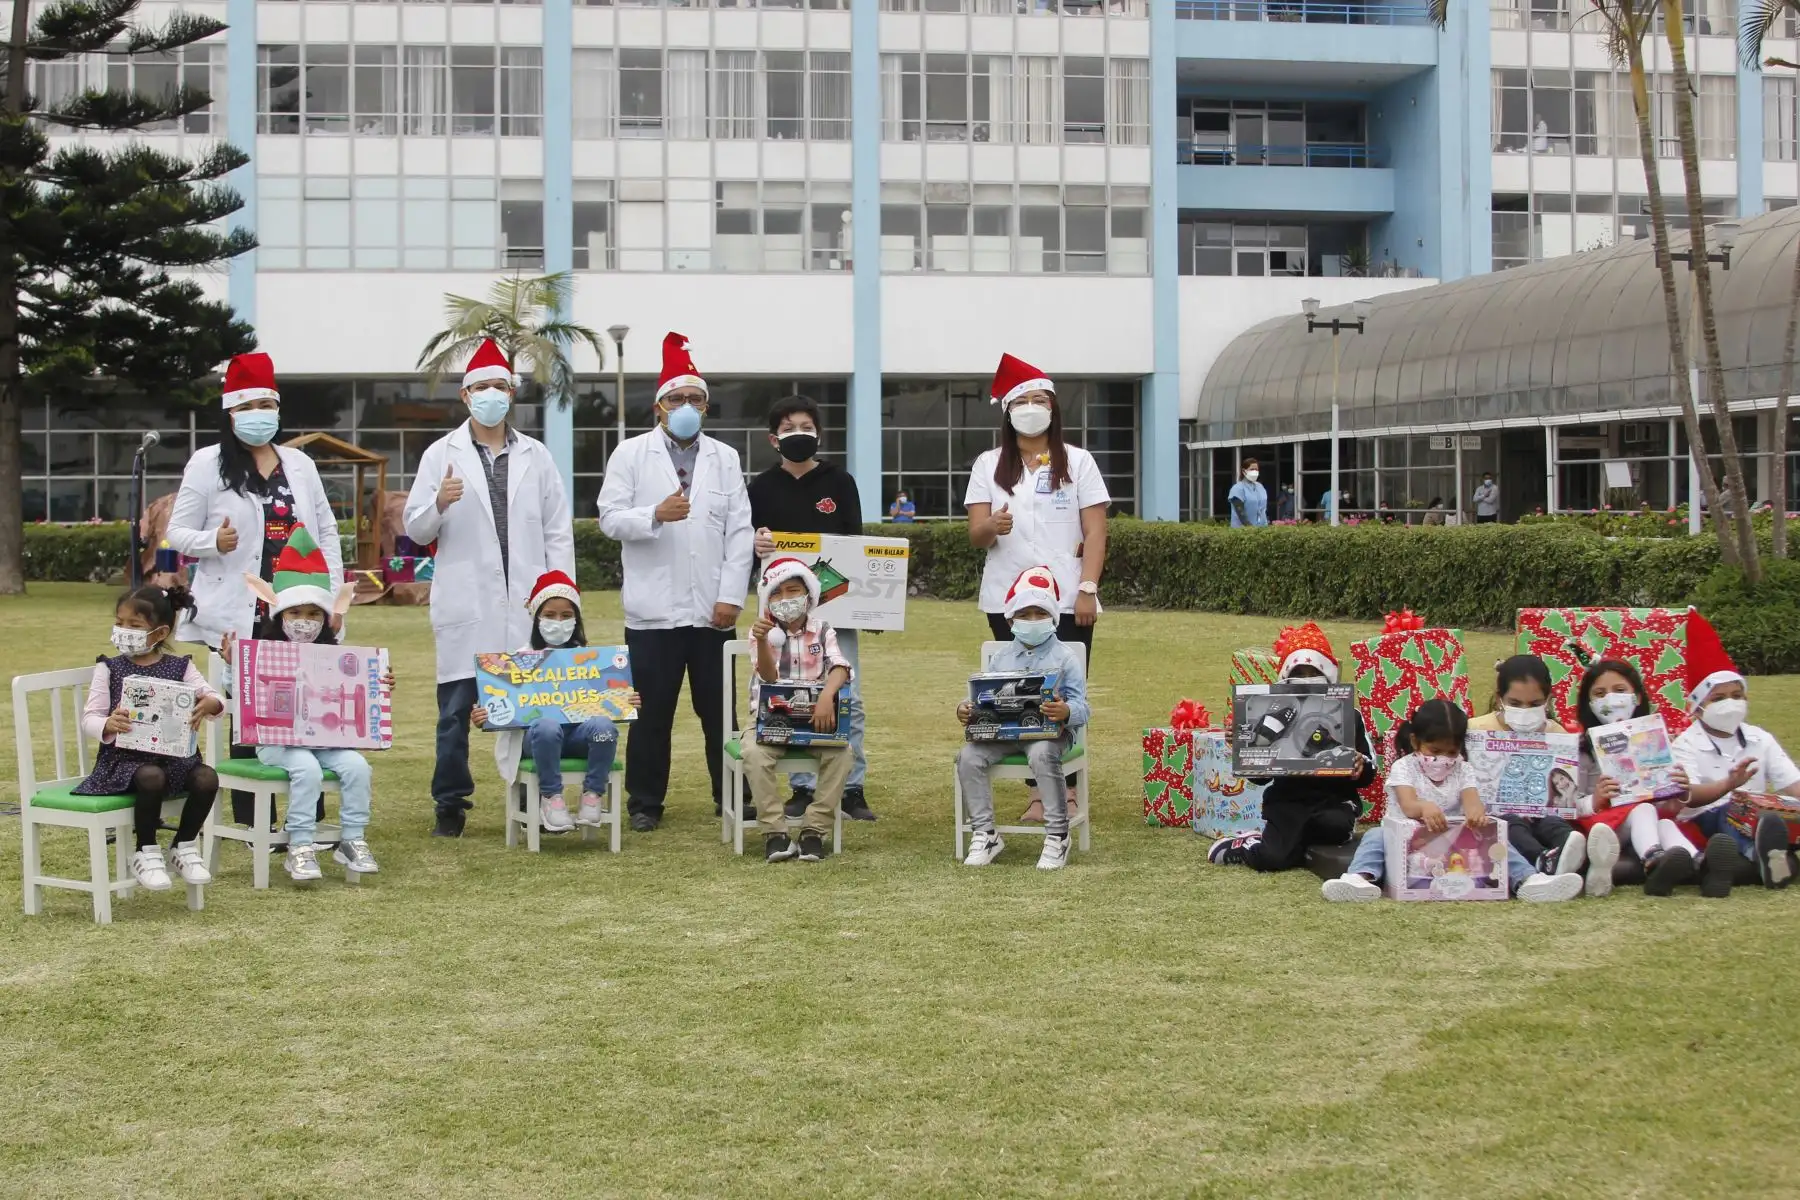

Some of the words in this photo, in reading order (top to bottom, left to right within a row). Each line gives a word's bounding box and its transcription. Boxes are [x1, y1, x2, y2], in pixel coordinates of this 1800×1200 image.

[1445, 437, 1453, 448] B
[776, 540, 816, 550] RADOST
[847, 576, 906, 600] OST
[243, 644, 251, 675] Kitchen
[367, 658, 379, 699] Little
[510, 665, 601, 684] ESCALERA
[243, 676, 252, 705] Playset
[552, 680, 560, 691] Y
[487, 702, 498, 713] 2
[500, 698, 508, 708] 1
[518, 686, 600, 708] PARQUÉS
[369, 704, 381, 742] Chef
[1487, 740, 1520, 751] CHARM
[1241, 758, 1272, 766] SPEED
